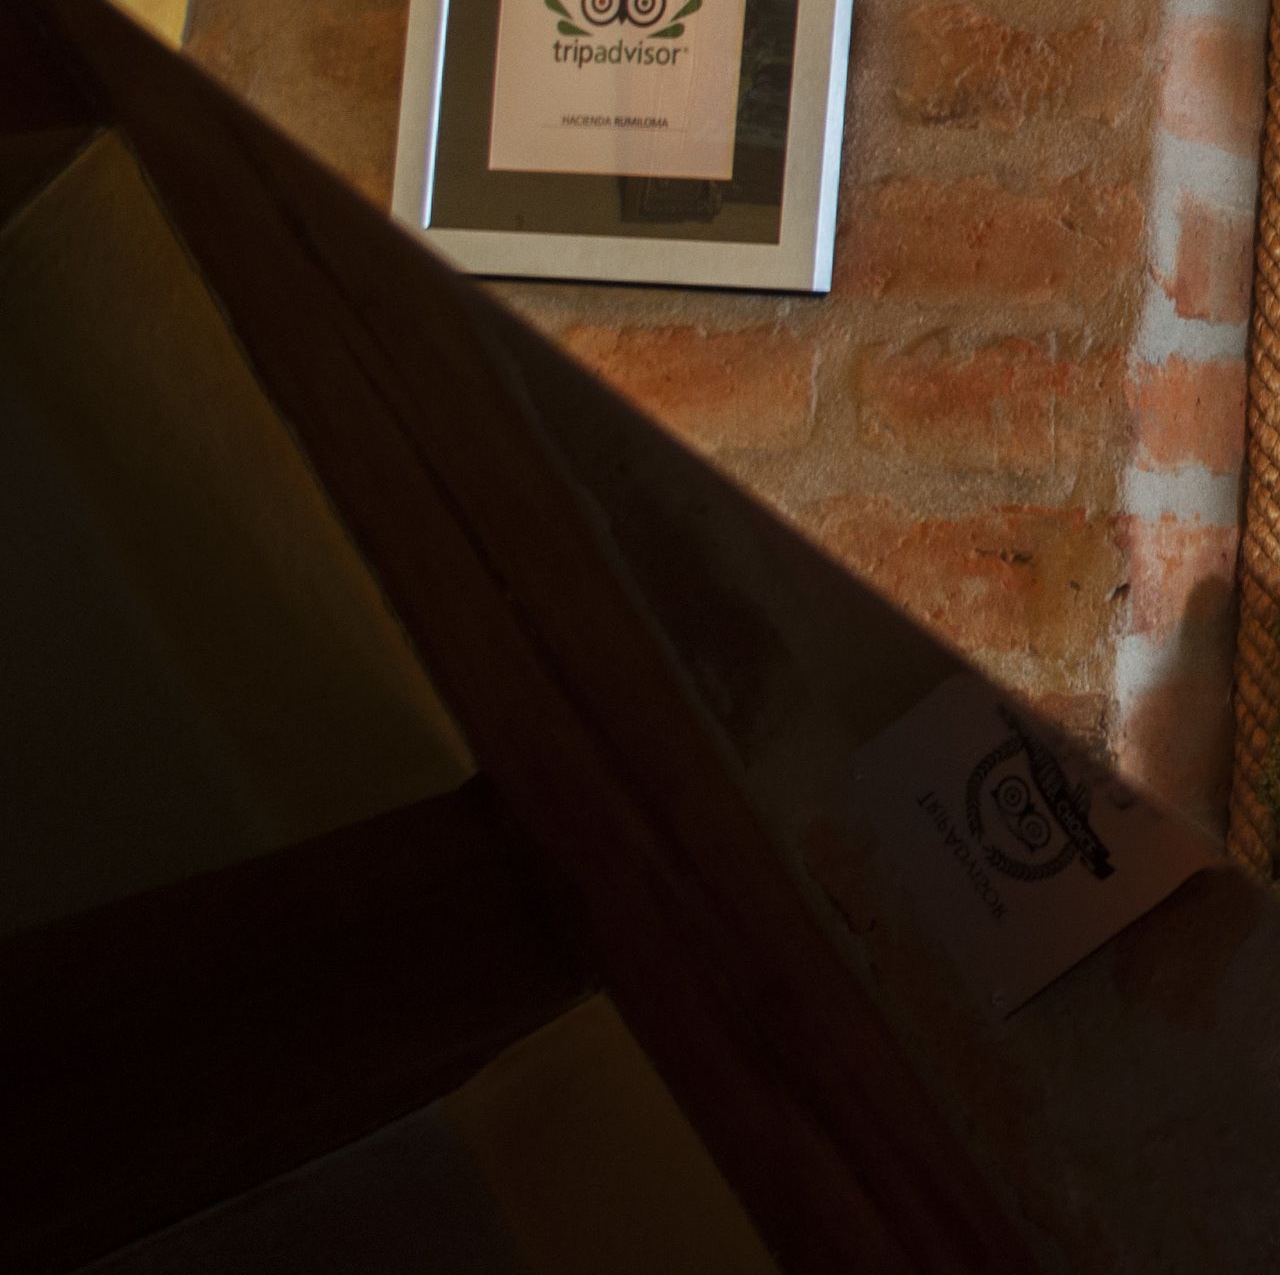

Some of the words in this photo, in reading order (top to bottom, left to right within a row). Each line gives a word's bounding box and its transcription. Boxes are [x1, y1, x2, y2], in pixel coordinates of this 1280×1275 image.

[553, 37, 682, 69] tripadvisor
[562, 114, 612, 127] HACIENDA
[613, 116, 669, 129] RUMILOMA
